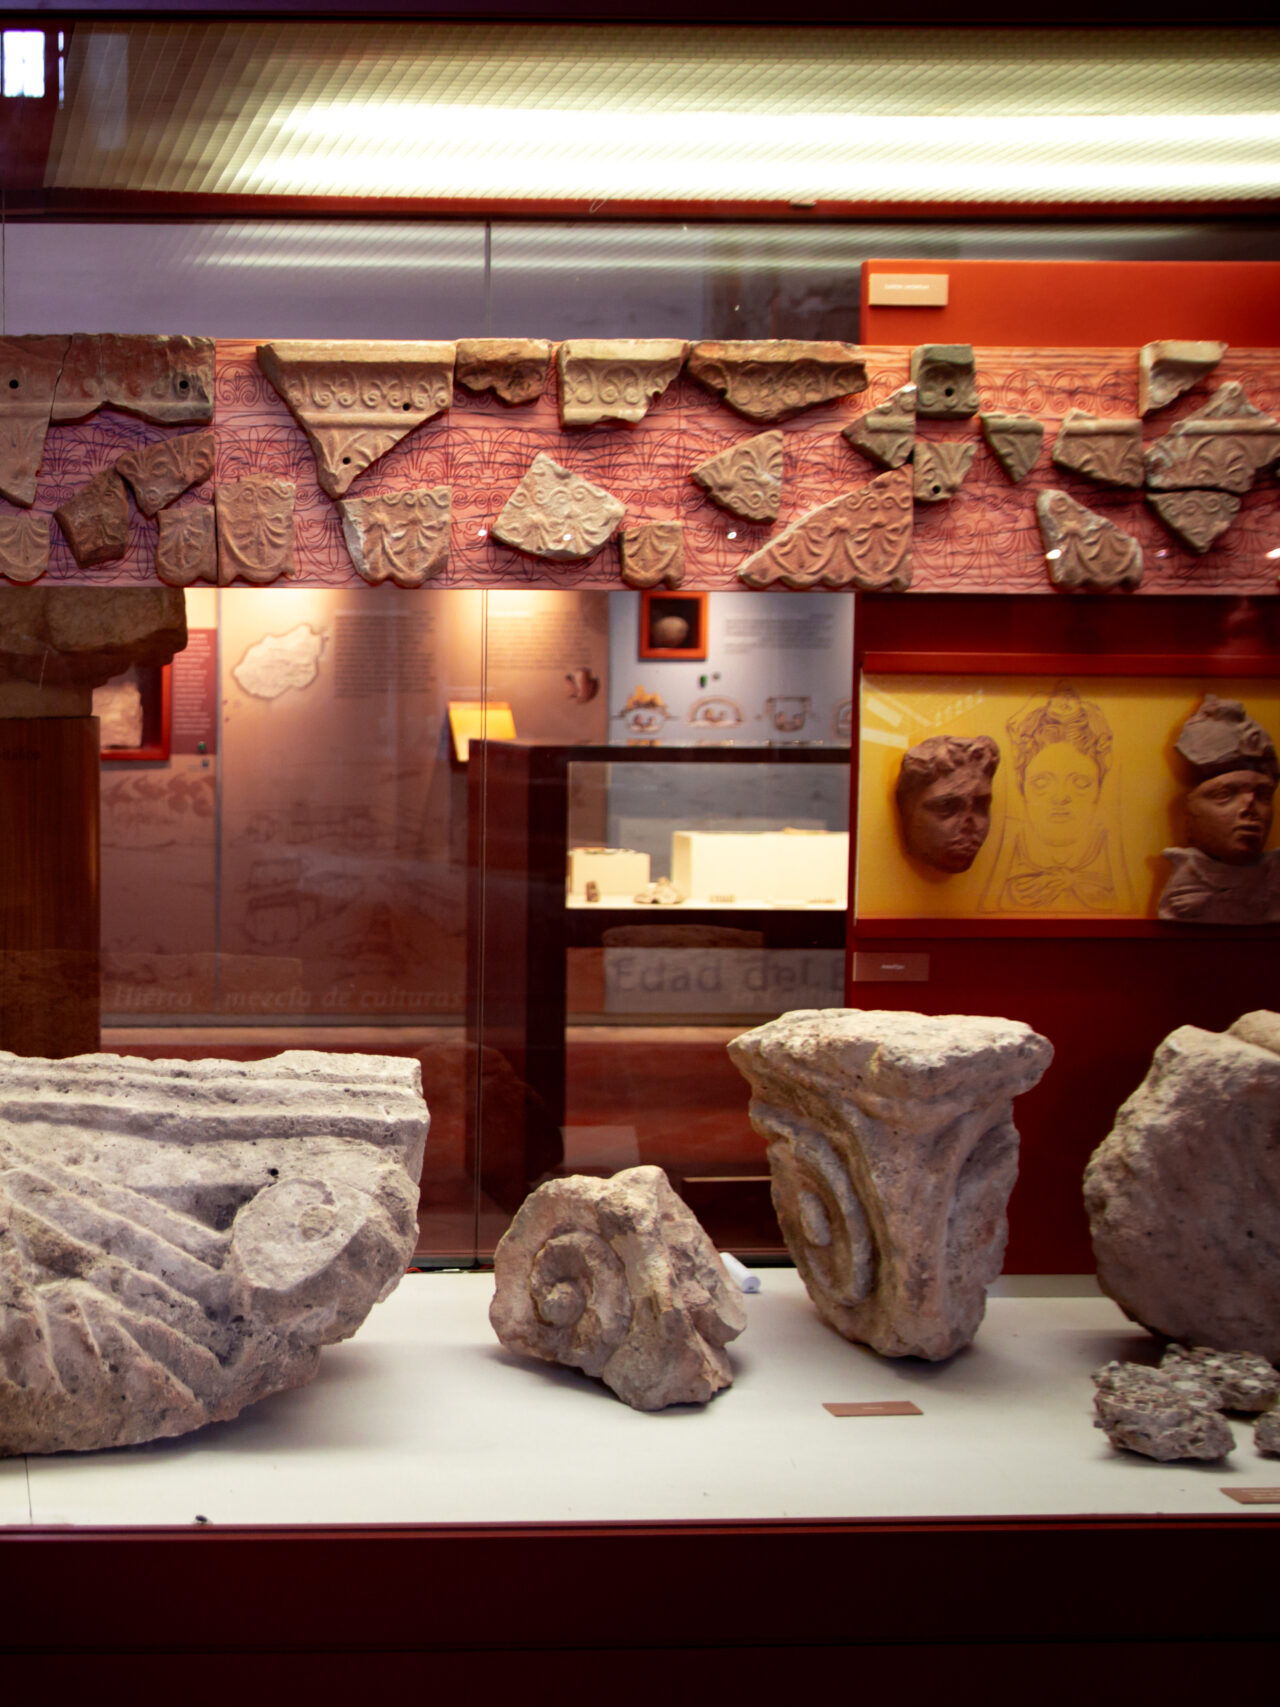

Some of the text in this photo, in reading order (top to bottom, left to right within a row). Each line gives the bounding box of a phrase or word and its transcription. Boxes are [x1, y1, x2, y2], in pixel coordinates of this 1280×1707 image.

[612, 955, 723, 993] Edad
[743, 954, 811, 993] del
[112, 984, 193, 1008] Hierro
[224, 984, 466, 1009] mezcla de culturas
